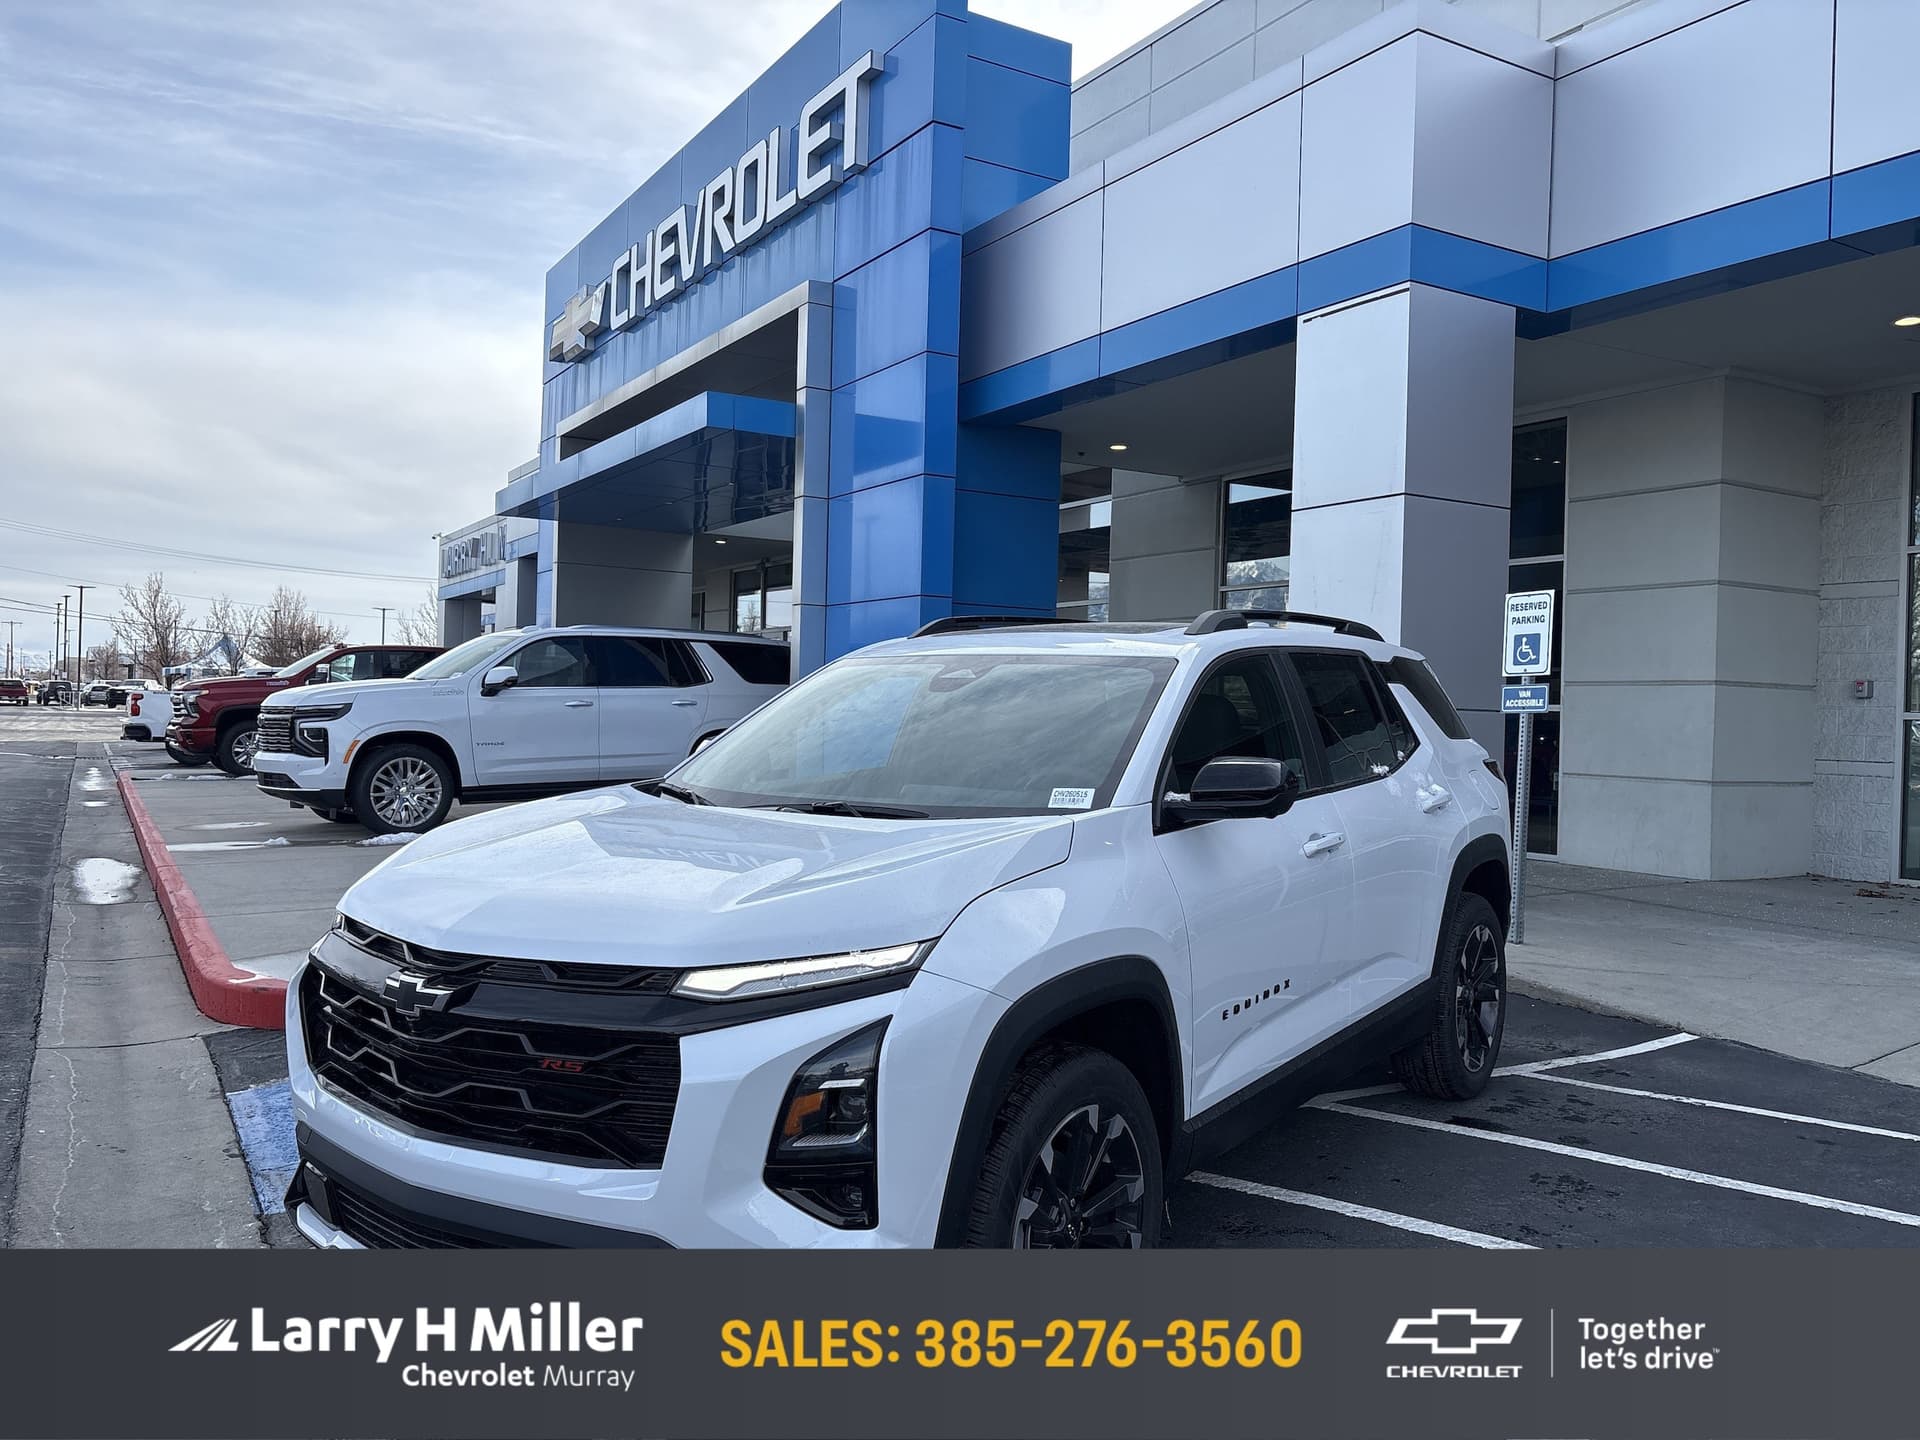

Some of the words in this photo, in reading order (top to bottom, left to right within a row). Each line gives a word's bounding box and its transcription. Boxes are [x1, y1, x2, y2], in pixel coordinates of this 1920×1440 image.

[610, 49, 884, 331] CHEVROLET
[441, 538, 478, 578] LARRY
[1510, 601, 1548, 612] RESERVED
[1511, 614, 1546, 625] PARKING
[1518, 690, 1531, 698] VAN
[1505, 698, 1545, 707] ACCESSIBLE
[1222, 979, 1290, 1021] EQUINOX
[542, 1058, 584, 1073] RS
